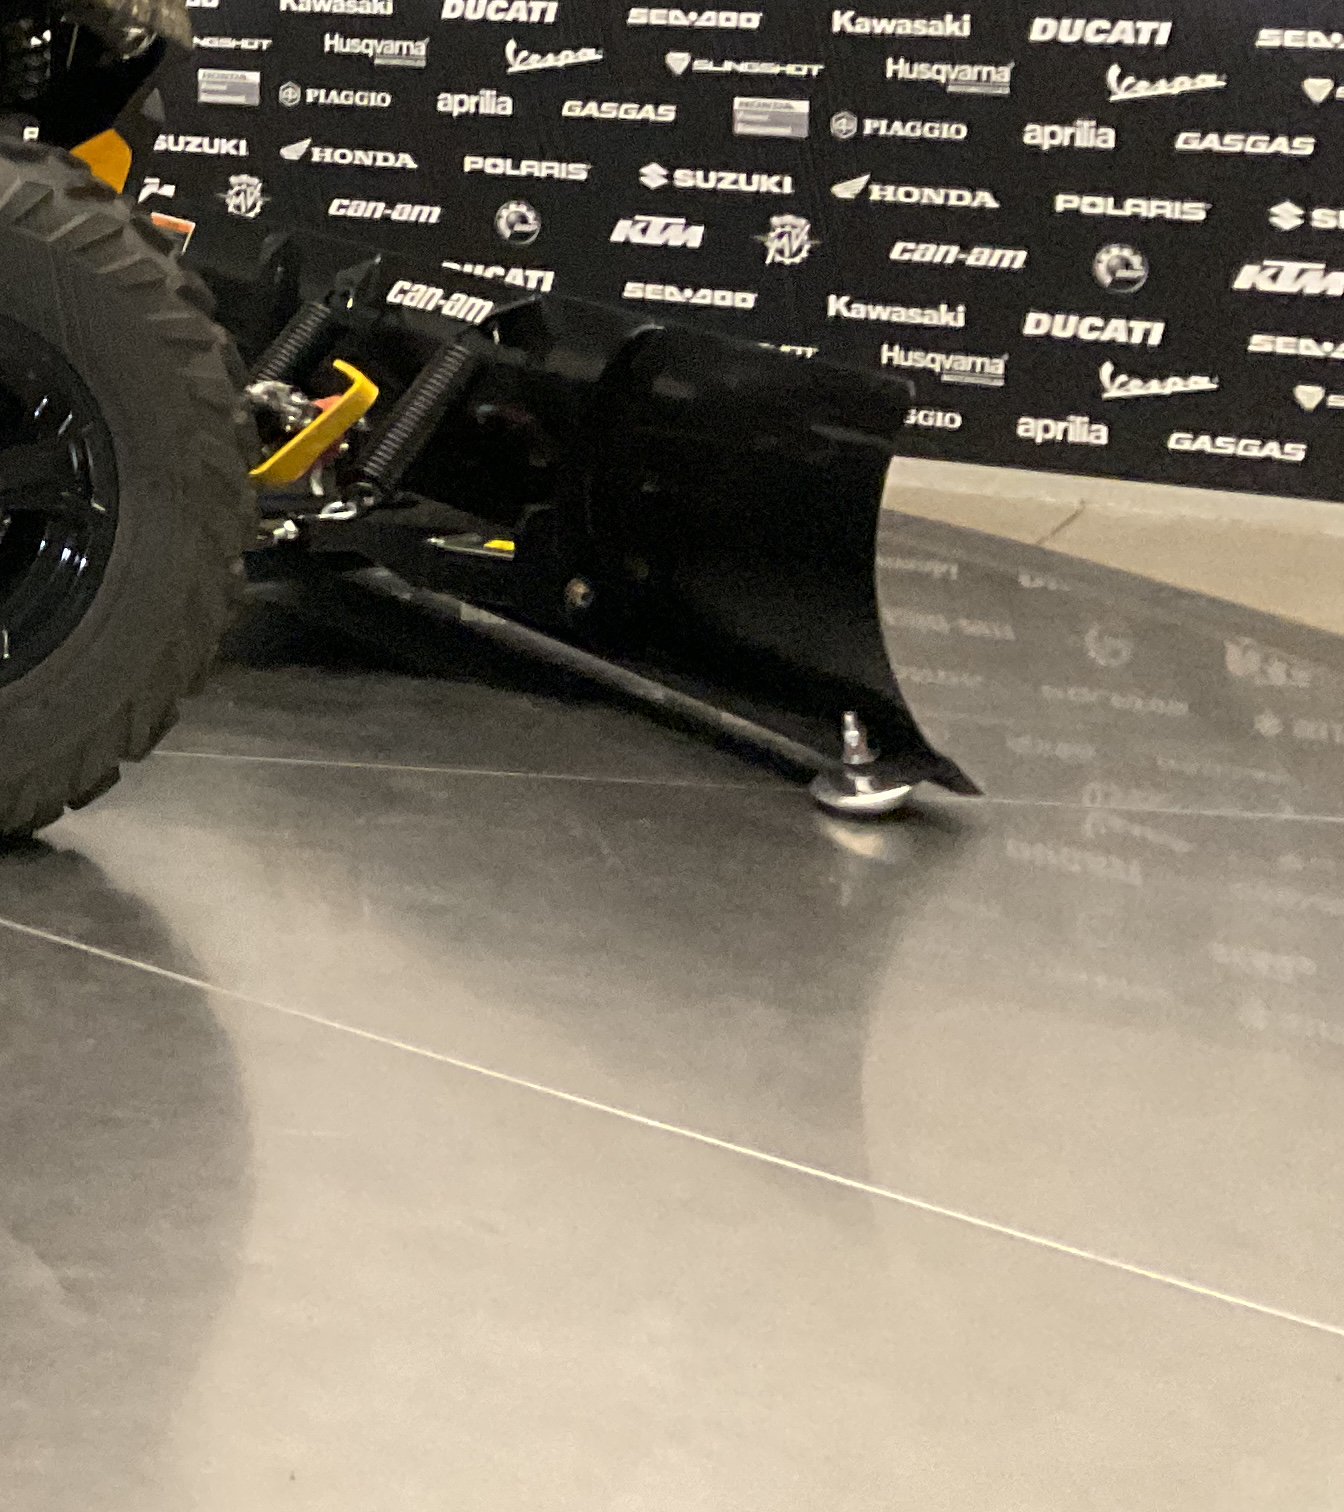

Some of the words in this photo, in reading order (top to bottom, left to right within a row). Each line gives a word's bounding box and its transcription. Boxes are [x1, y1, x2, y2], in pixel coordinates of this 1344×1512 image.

[831, 9, 972, 39] Kawasaki
[1028, 16, 1173, 47] DUCATI
[324, 33, 426, 60] Husqvarna
[505, 38, 603, 74] Vespa
[692, 59, 824, 78] SLINGSHOT
[885, 56, 1012, 86] Husqvarna
[1106, 63, 1226, 103] Vespa
[305, 87, 392, 108] PIAGGIO
[436, 89, 513, 118] aprilia
[562, 100, 677, 123] GASGAS
[863, 119, 968, 140] PIAGGIO
[1023, 118, 1116, 152] aprilia
[1175, 131, 1315, 156] GASGAS
[154, 133, 250, 157] SUZUKI
[312, 146, 419, 169] HONDA
[463, 155, 590, 182] POLARIS
[673, 168, 795, 195] SUZUKI
[327, 197, 442, 224] can-am
[869, 183, 1000, 209] HONDA
[1055, 193, 1210, 222] POLARIS
[610, 214, 705, 249] KTM
[888, 240, 1028, 270] can-am
[1231, 259, 1344, 297] KTM
[386, 280, 494, 325] can-am
[826, 293, 966, 328] Kawasaki
[1022, 311, 1166, 348] DUCATI
[880, 343, 1007, 374] Husqvarna
[1098, 360, 1219, 401] Vespa
[1015, 414, 1109, 446] aprilia
[1166, 431, 1308, 462] GASGAS
